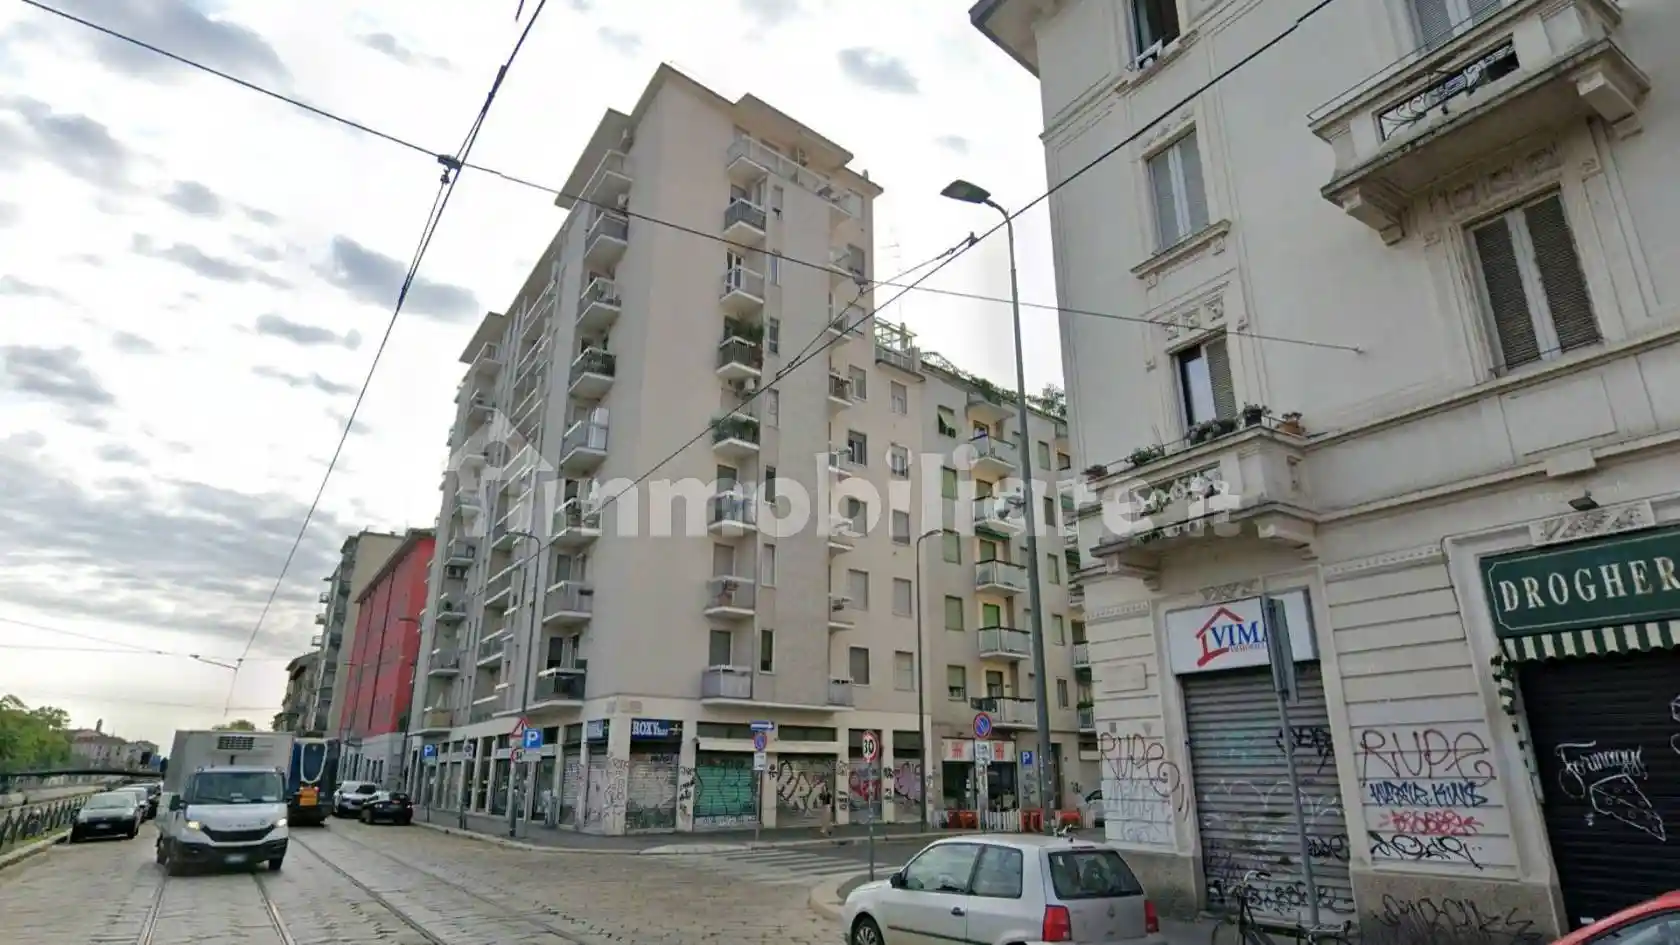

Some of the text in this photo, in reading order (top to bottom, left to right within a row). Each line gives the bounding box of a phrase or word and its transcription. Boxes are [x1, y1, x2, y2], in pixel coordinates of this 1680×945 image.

[1499, 556, 1680, 613] DROGHER
[1211, 620, 1267, 648] VIM
[864, 739, 874, 754] 30
